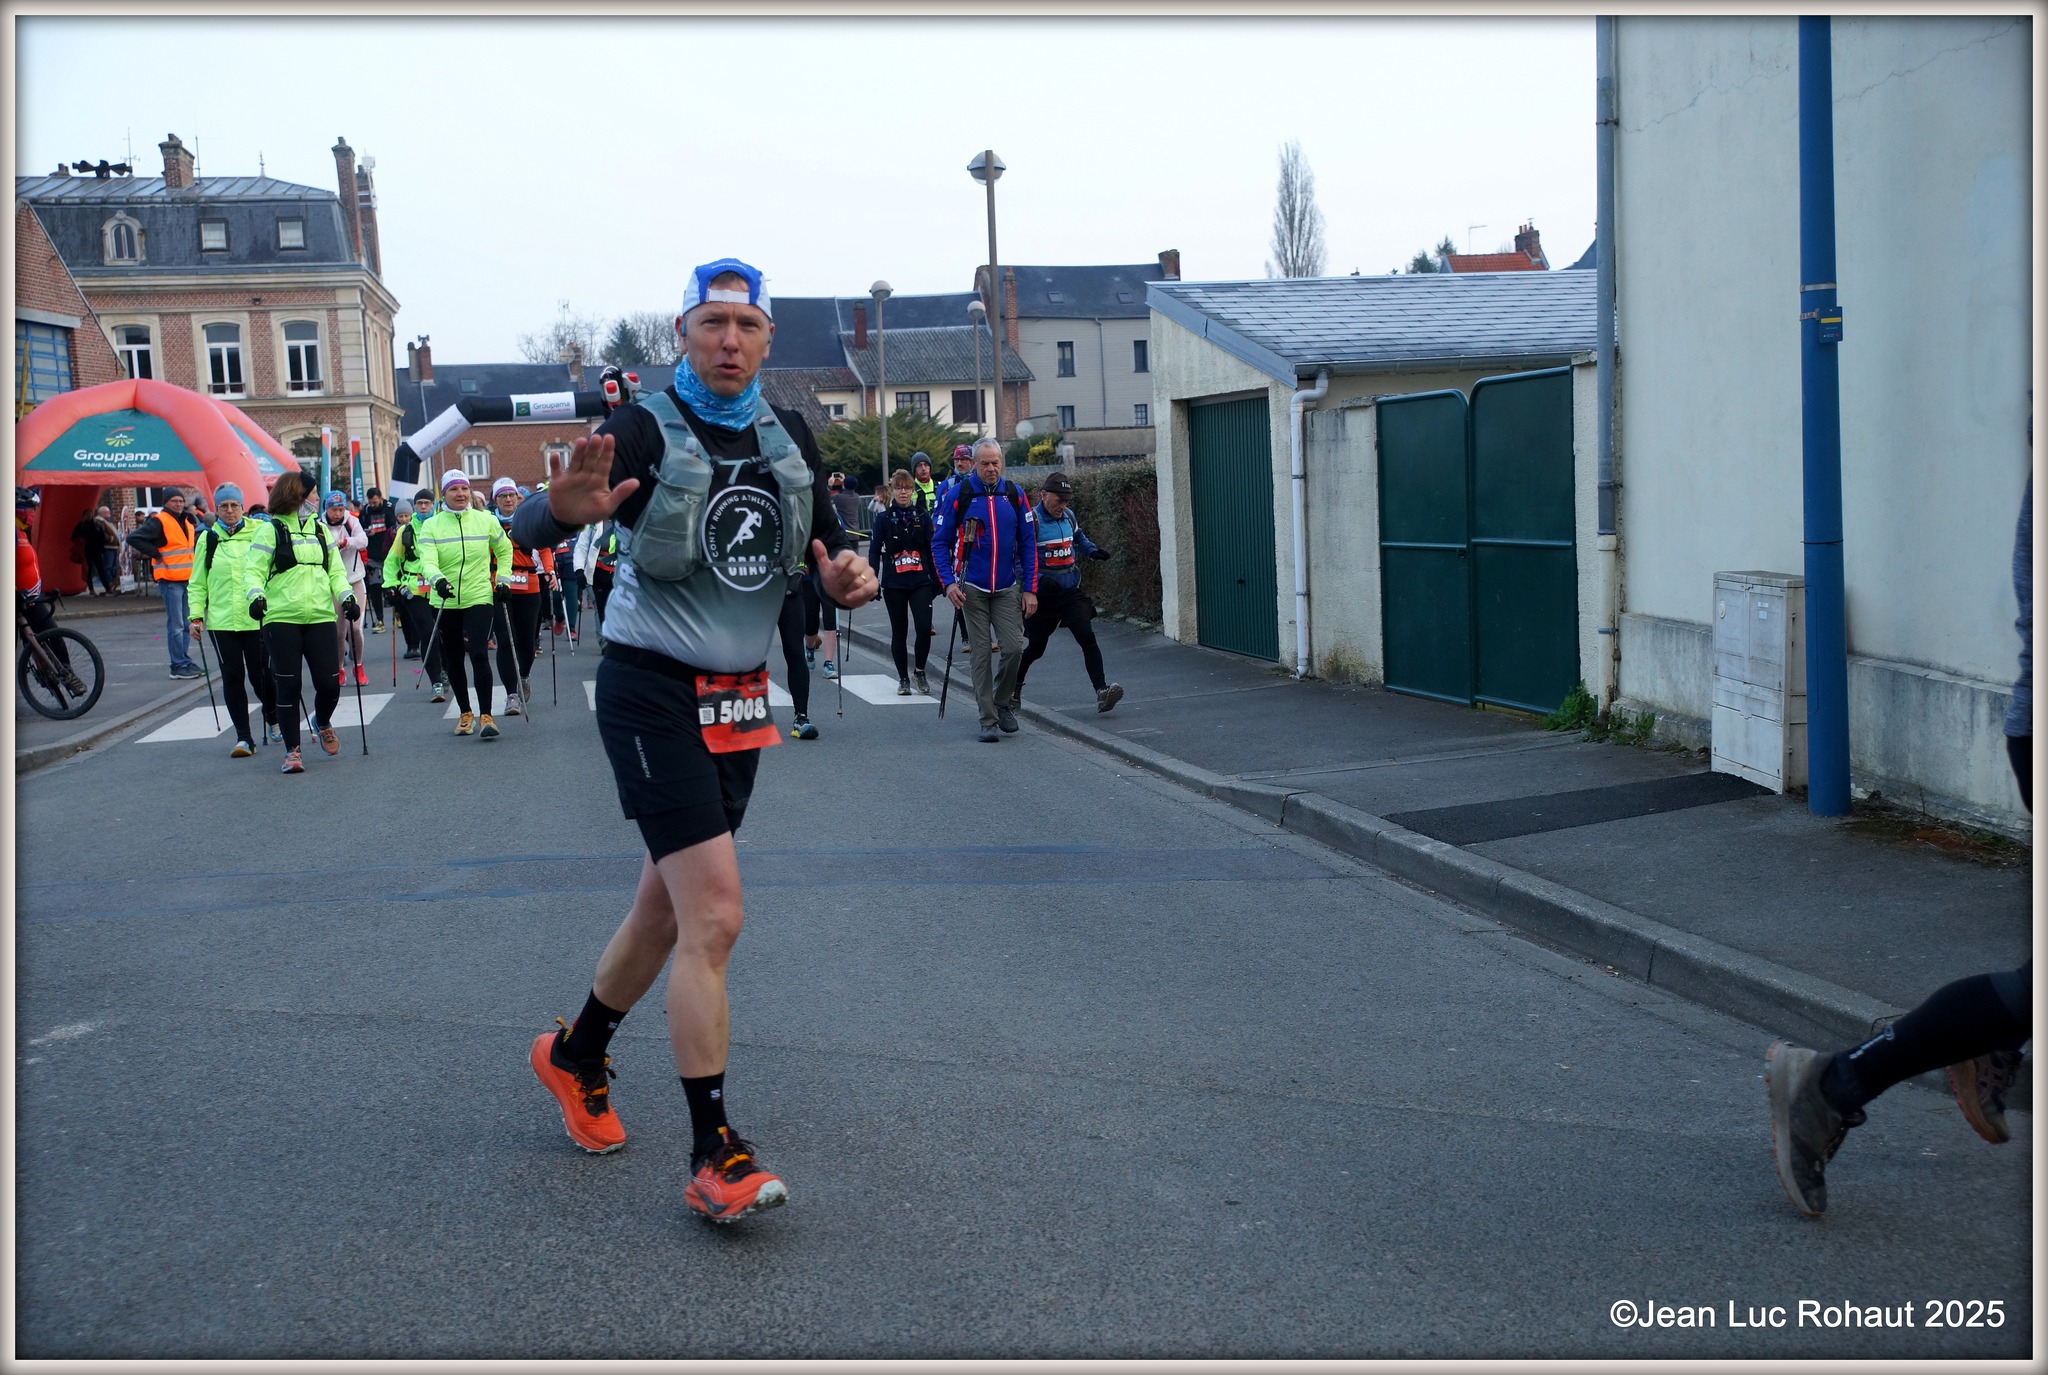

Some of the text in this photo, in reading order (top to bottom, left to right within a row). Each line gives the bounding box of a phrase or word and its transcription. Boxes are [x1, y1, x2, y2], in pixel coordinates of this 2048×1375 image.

[533, 401, 571, 409] Groupama
[73, 449, 160, 463] Groupama
[712, 495, 740, 522] RUNNING
[709, 524, 720, 558] CONTY
[510, 574, 527, 583] 006
[720, 696, 767, 724] 5008
[634, 735, 652, 778] SALOMON
